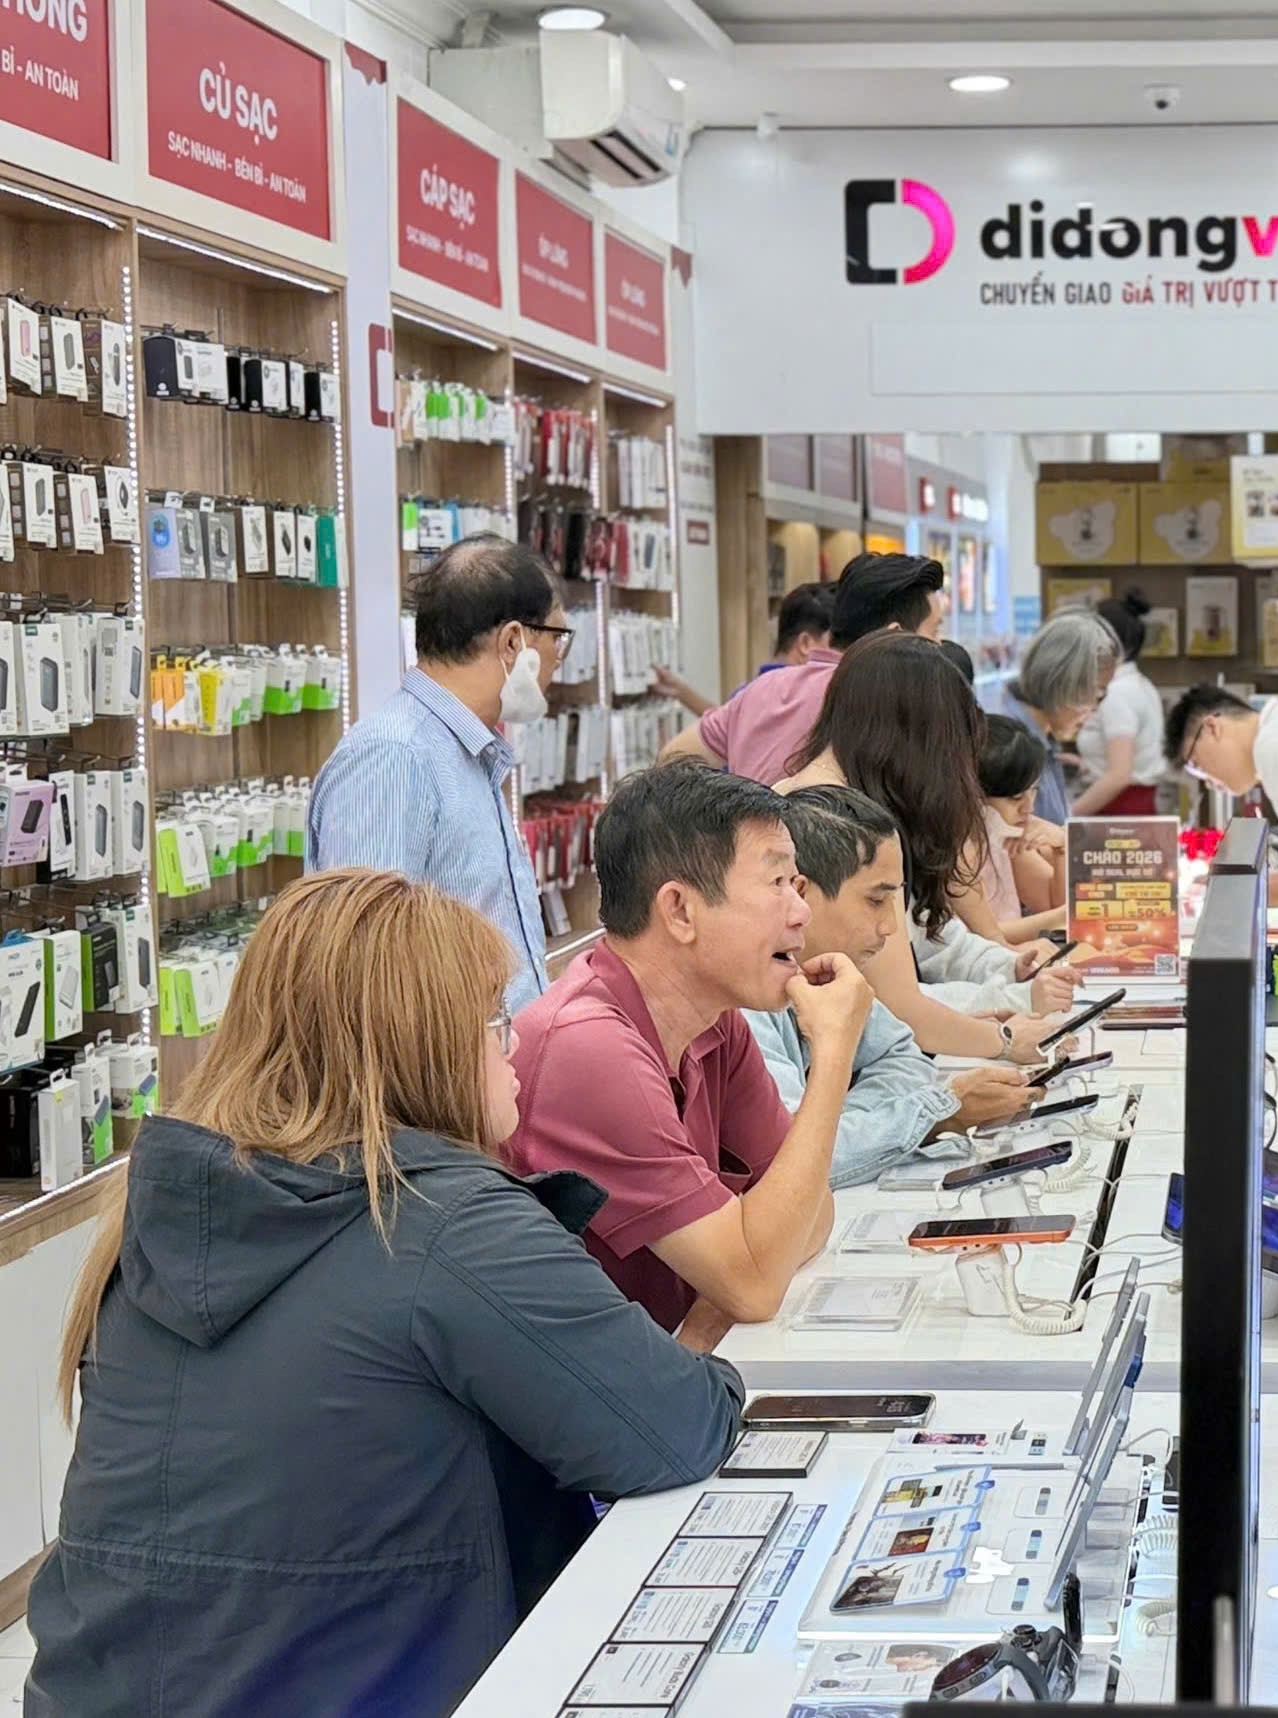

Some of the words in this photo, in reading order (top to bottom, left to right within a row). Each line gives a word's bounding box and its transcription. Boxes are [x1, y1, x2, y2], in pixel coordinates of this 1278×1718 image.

[1, 45, 14, 75] BỈ
[25, 60, 44, 87] AN
[45, 67, 79, 101] TOÀN
[199, 61, 232, 120] CỦ
[235, 84, 278, 146] SẠC
[168, 130, 190, 158] SẠC
[190, 138, 227, 172] NHANH
[420, 163, 448, 212] CÁP
[449, 182, 475, 231] SẠC
[980, 271, 1056, 306] CHUYỂN
[1064, 282, 1112, 306] GIAO
[1164, 280, 1194, 309] TRỊ
[1203, 278, 1260, 309] VƯỢT
[1126, 850, 1164, 866] 2026
